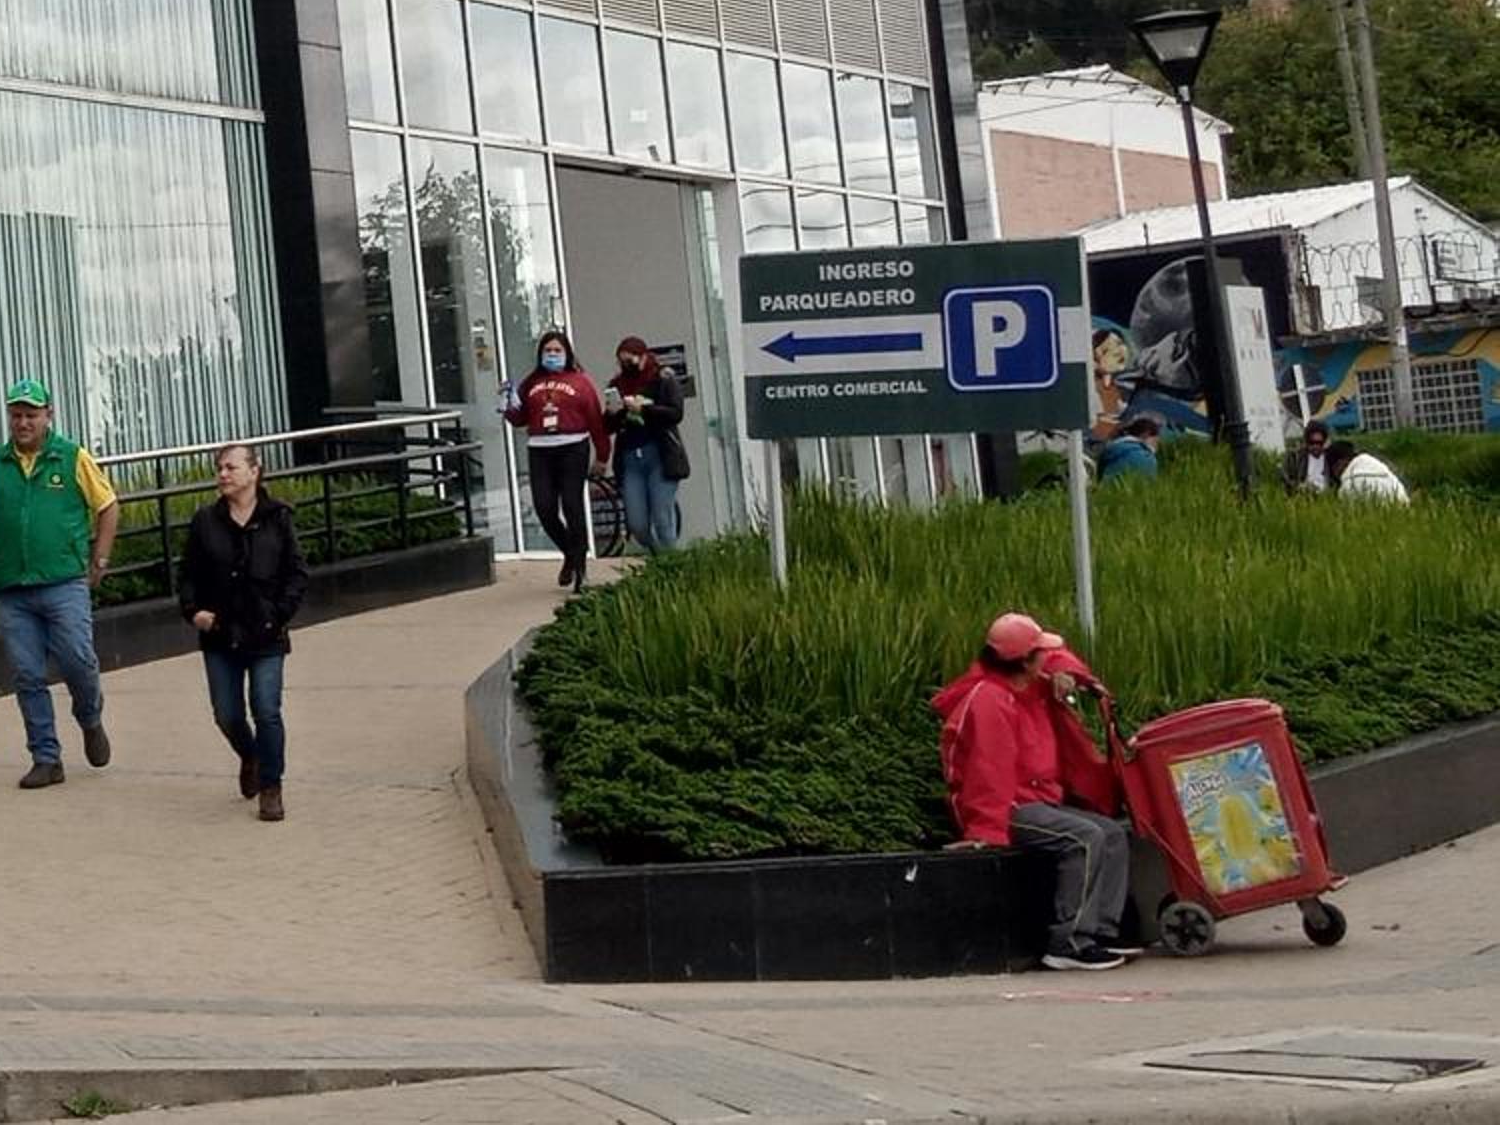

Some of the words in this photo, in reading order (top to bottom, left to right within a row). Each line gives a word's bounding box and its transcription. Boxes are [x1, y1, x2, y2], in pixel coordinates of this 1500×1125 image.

[818, 261, 915, 282] INGRESO
[759, 288, 916, 312] PARQUEADERO
[971, 300, 1027, 377] P
[765, 383, 829, 399] CENTRO
[832, 379, 928, 397] COMERCIAL
